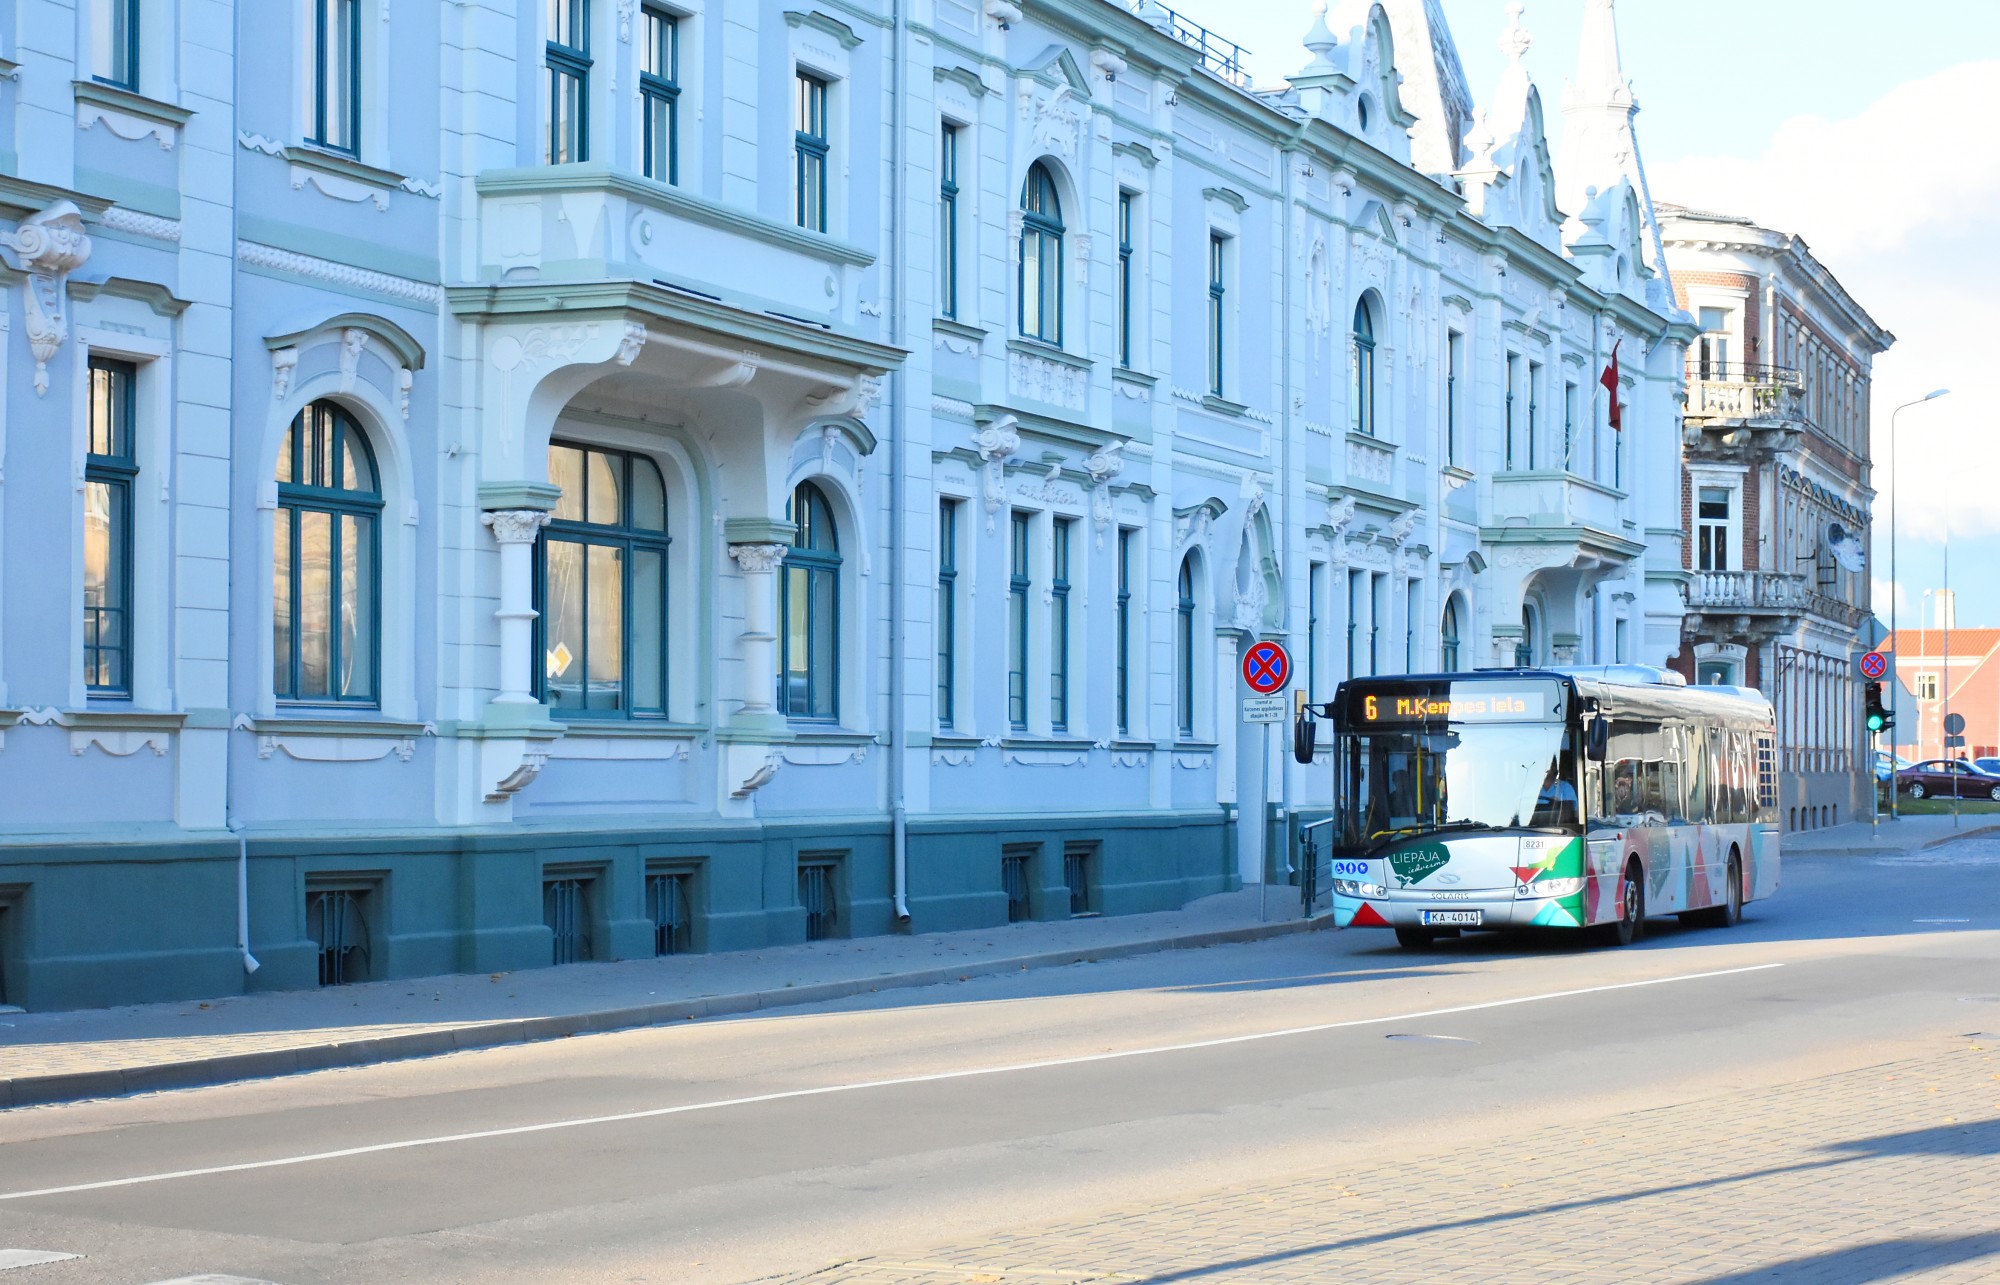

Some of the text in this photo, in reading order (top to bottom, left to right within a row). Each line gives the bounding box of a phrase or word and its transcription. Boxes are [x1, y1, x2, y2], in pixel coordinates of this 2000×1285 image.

[1365, 695, 1525, 720] 6 M.Ķempes iela
[1525, 840, 1544, 848] 8231
[1393, 851, 1440, 863] LIEPĀJA
[1431, 892, 1469, 900] SOLARIS
[1431, 912, 1475, 922] KA-4014
